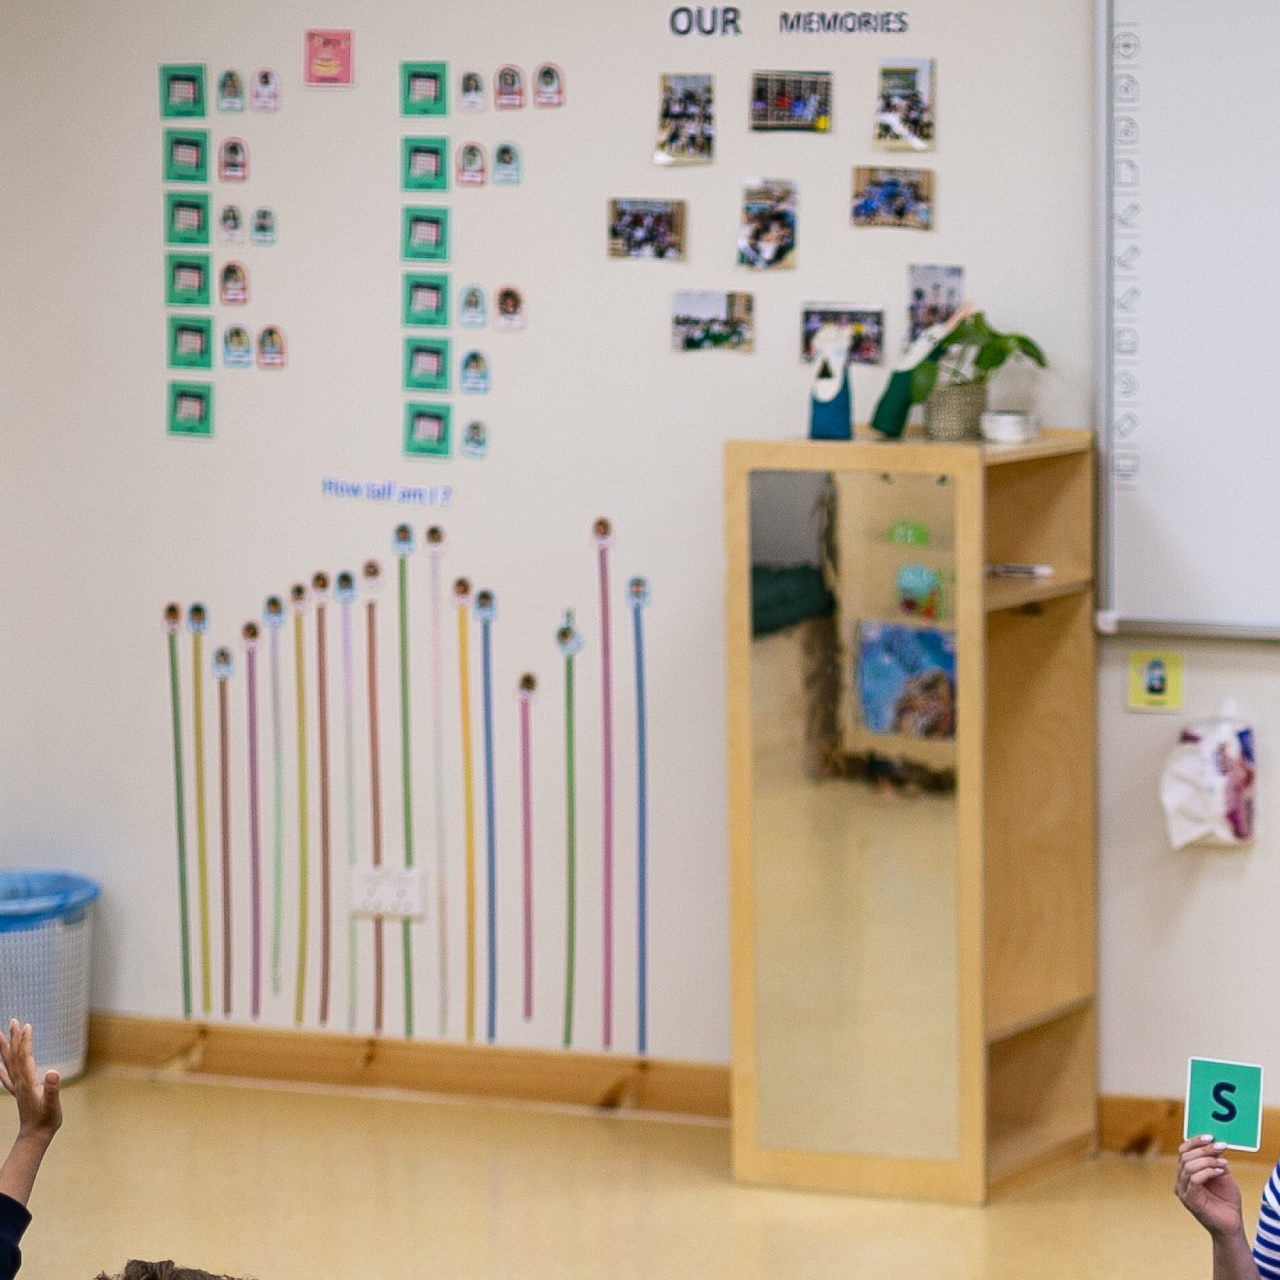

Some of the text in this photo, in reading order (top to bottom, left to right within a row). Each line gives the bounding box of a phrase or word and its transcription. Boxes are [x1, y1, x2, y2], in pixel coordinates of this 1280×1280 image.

[670, 6, 909, 36] OUR MEMORIES
[1211, 1081, 1237, 1123] S
